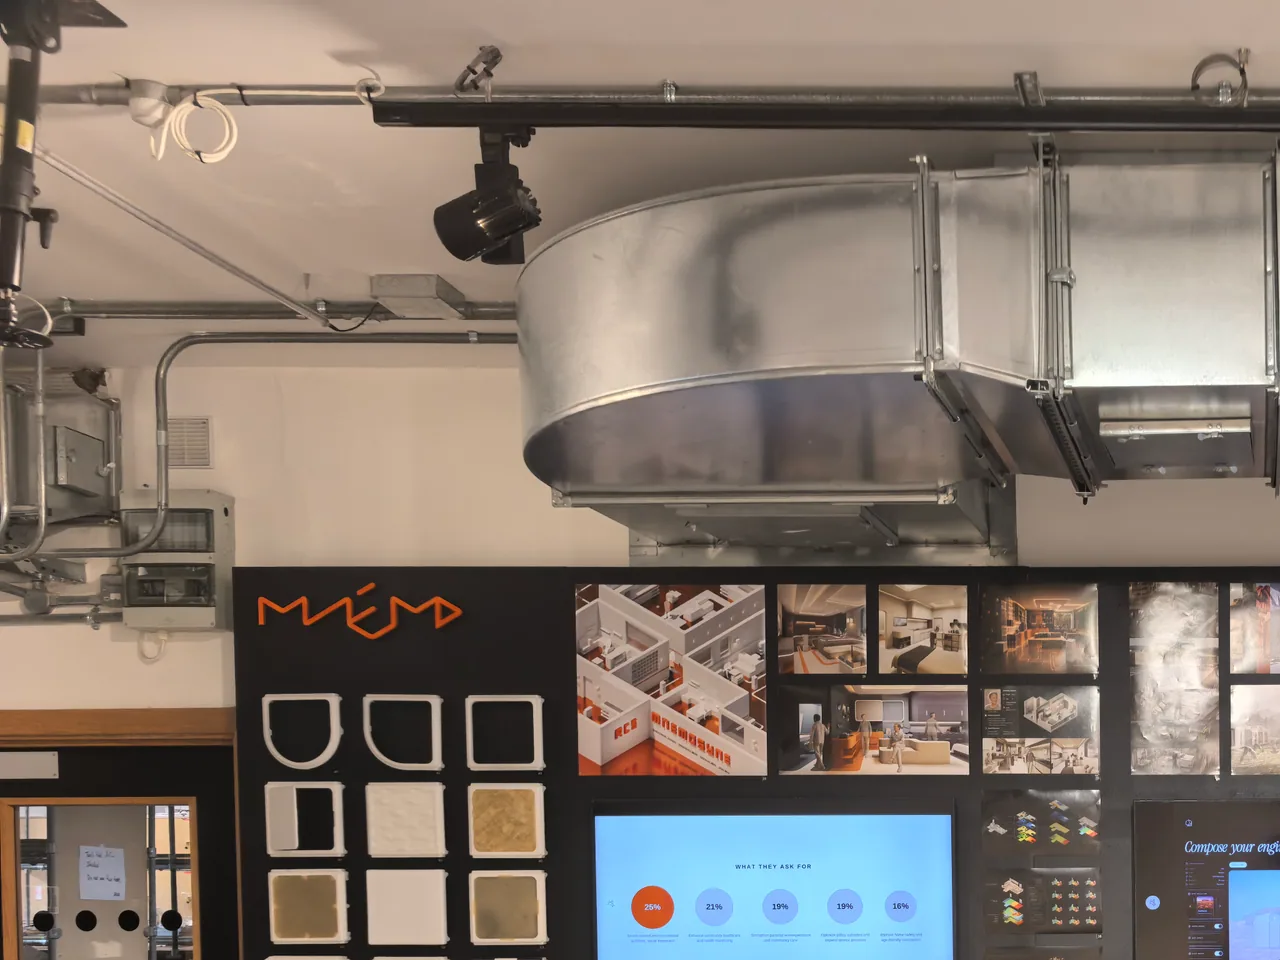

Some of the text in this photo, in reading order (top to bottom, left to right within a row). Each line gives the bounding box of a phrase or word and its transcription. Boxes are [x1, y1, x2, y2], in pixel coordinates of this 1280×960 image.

[1184, 840, 1228, 855] Compose
[1229, 843, 1255, 855] your
[706, 902, 723, 911] 21%
[772, 902, 788, 911] 19%
[836, 902, 854, 911] 19%
[892, 902, 910, 911] 16%
